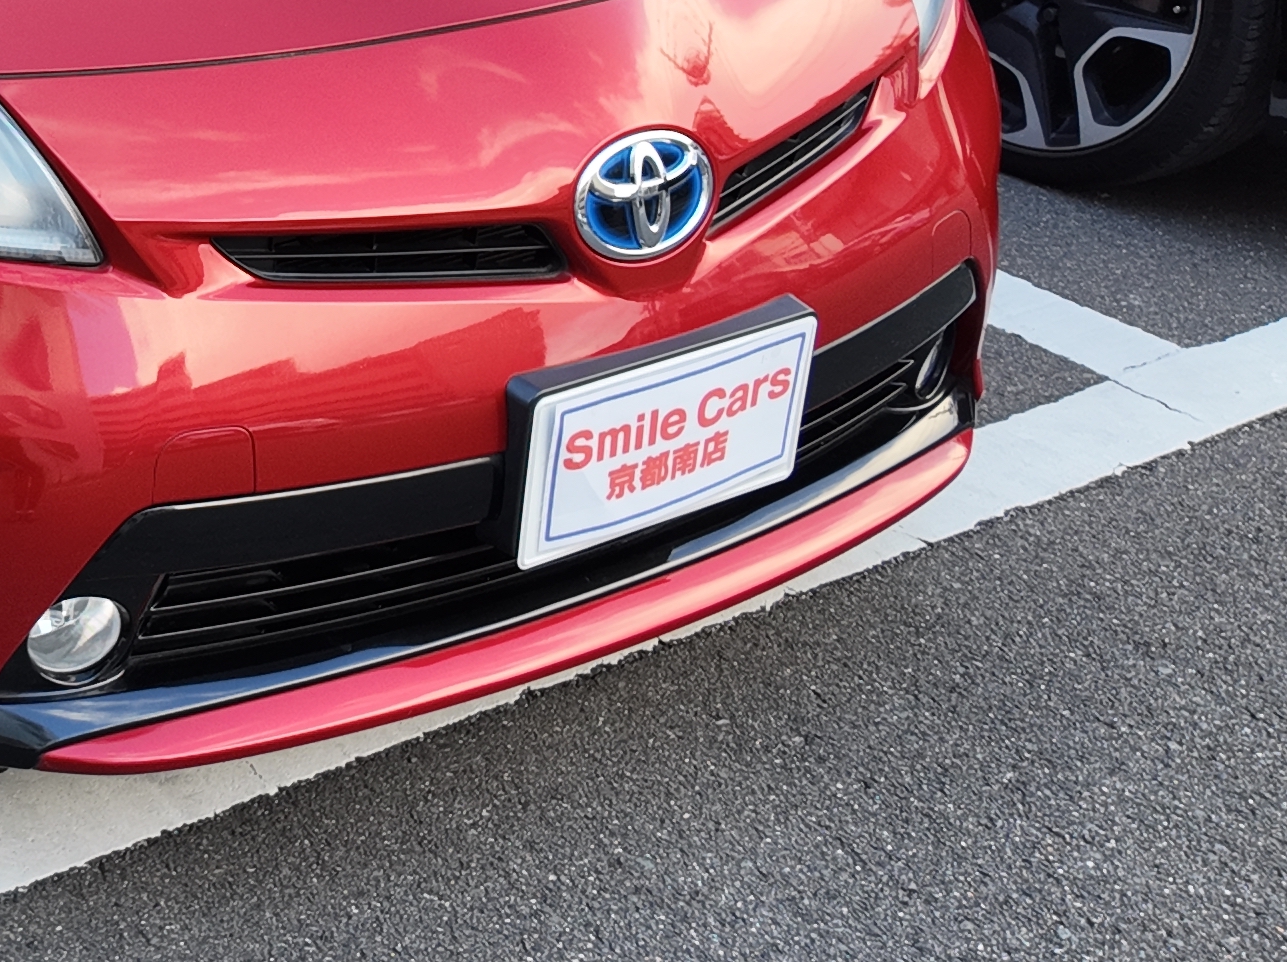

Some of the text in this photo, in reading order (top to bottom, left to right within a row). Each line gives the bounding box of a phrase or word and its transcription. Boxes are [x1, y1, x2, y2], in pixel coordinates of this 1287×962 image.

[563, 367, 791, 471] Smile Cars
[606, 430, 730, 501] 京都南店
